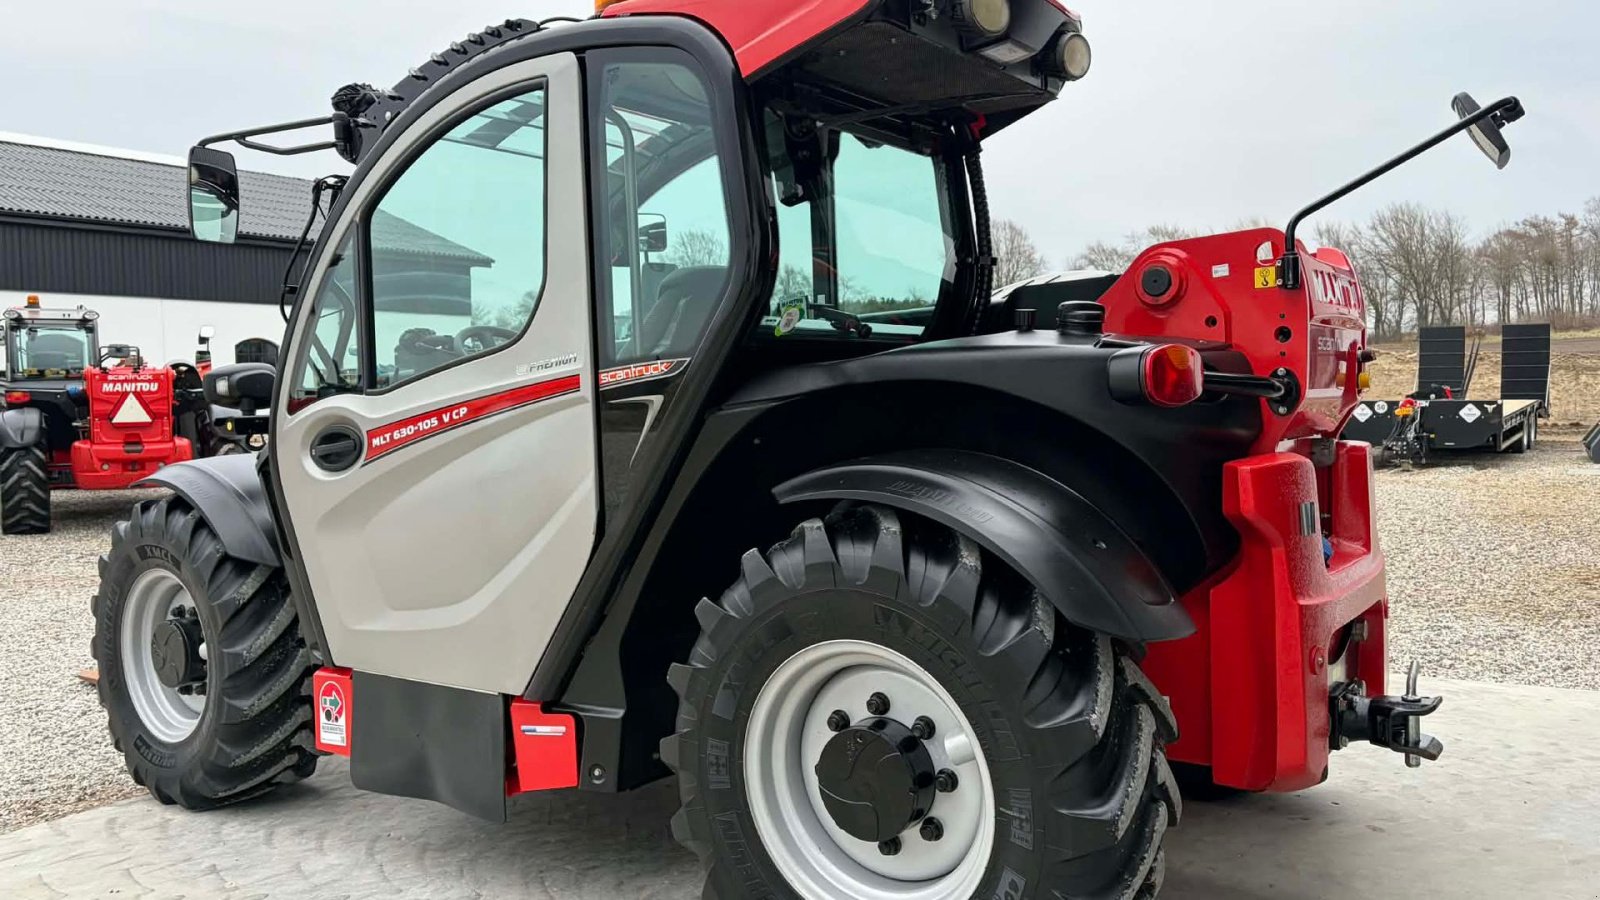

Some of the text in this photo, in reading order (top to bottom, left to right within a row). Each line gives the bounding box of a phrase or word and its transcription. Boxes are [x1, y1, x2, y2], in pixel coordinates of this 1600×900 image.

[529, 353, 578, 373] PREMIUM
[600, 361, 670, 384] scantruck
[102, 382, 159, 393] MANITOU
[371, 406, 469, 448] MLT 630-105 V CP
